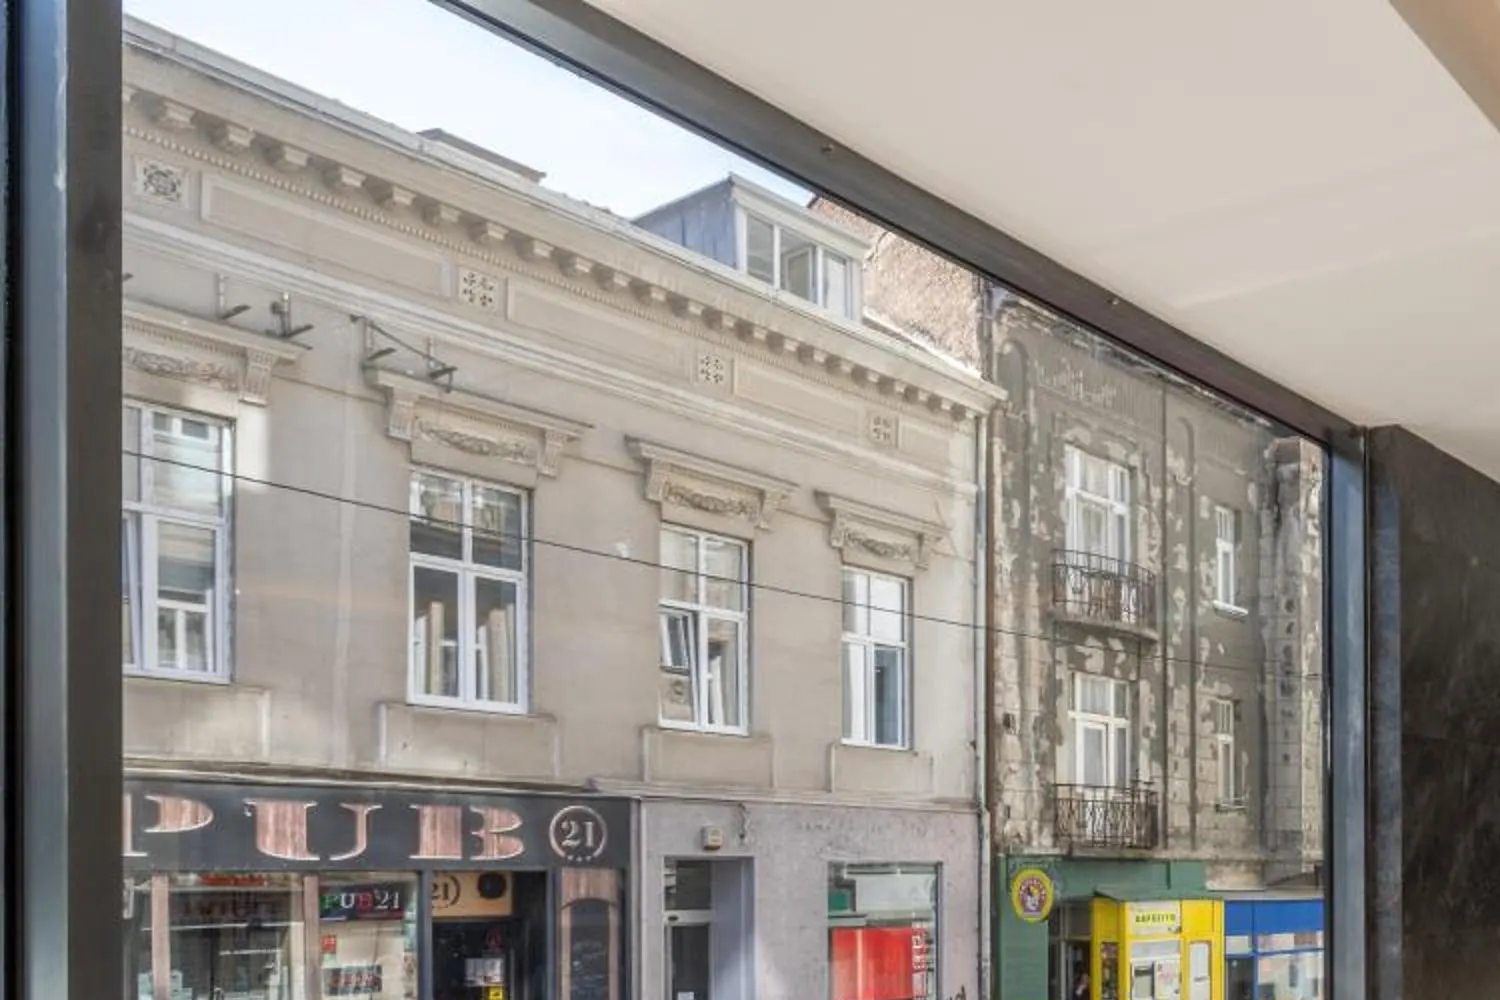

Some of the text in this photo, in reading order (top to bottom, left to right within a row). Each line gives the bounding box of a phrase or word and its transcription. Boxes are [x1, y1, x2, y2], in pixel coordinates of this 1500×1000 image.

[122, 793, 525, 861] PUB
[561, 819, 595, 847] 21
[375, 889, 400, 909] 21
